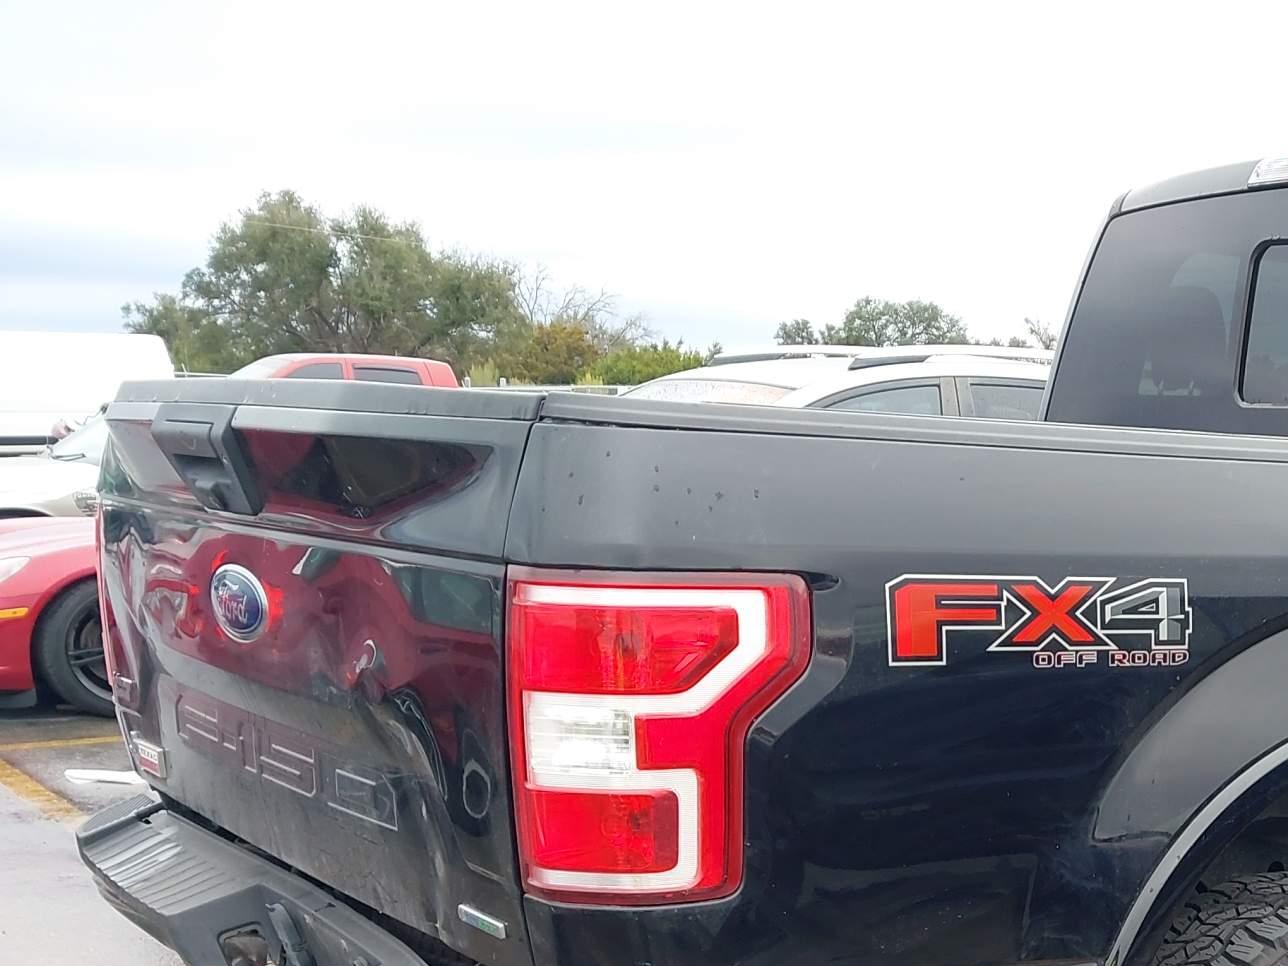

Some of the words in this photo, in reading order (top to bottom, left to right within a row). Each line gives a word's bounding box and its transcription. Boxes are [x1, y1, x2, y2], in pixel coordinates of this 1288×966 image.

[885, 574, 1192, 667] FX4
[1033, 651, 1098, 668] OFF
[1108, 649, 1190, 667] ROAD
